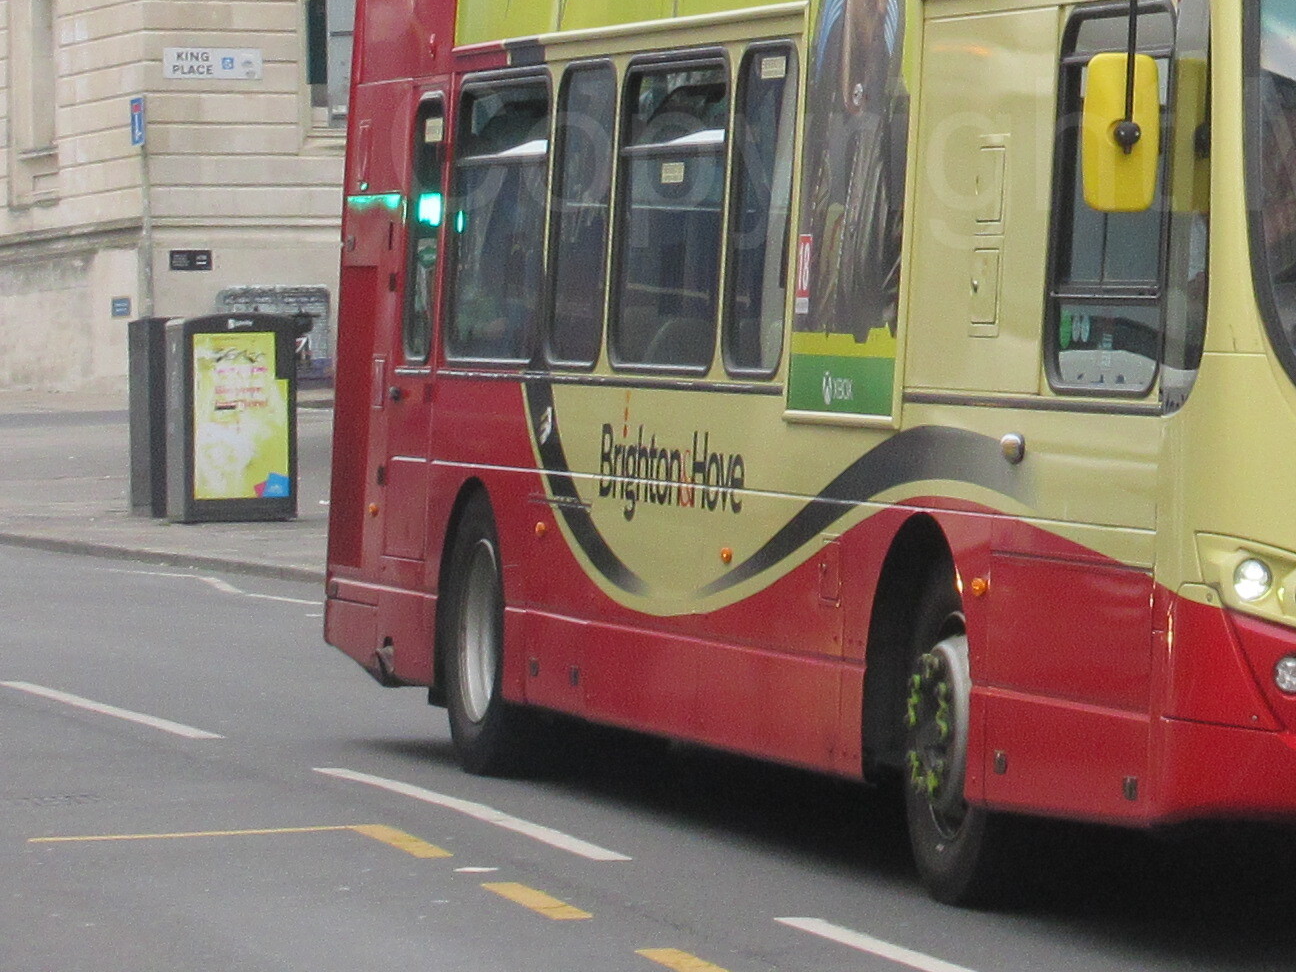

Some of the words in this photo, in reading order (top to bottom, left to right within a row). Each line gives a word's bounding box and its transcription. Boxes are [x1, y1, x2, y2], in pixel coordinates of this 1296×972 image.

[176, 51, 210, 62] KING
[172, 64, 214, 75] PLACE
[799, 242, 811, 291] 18
